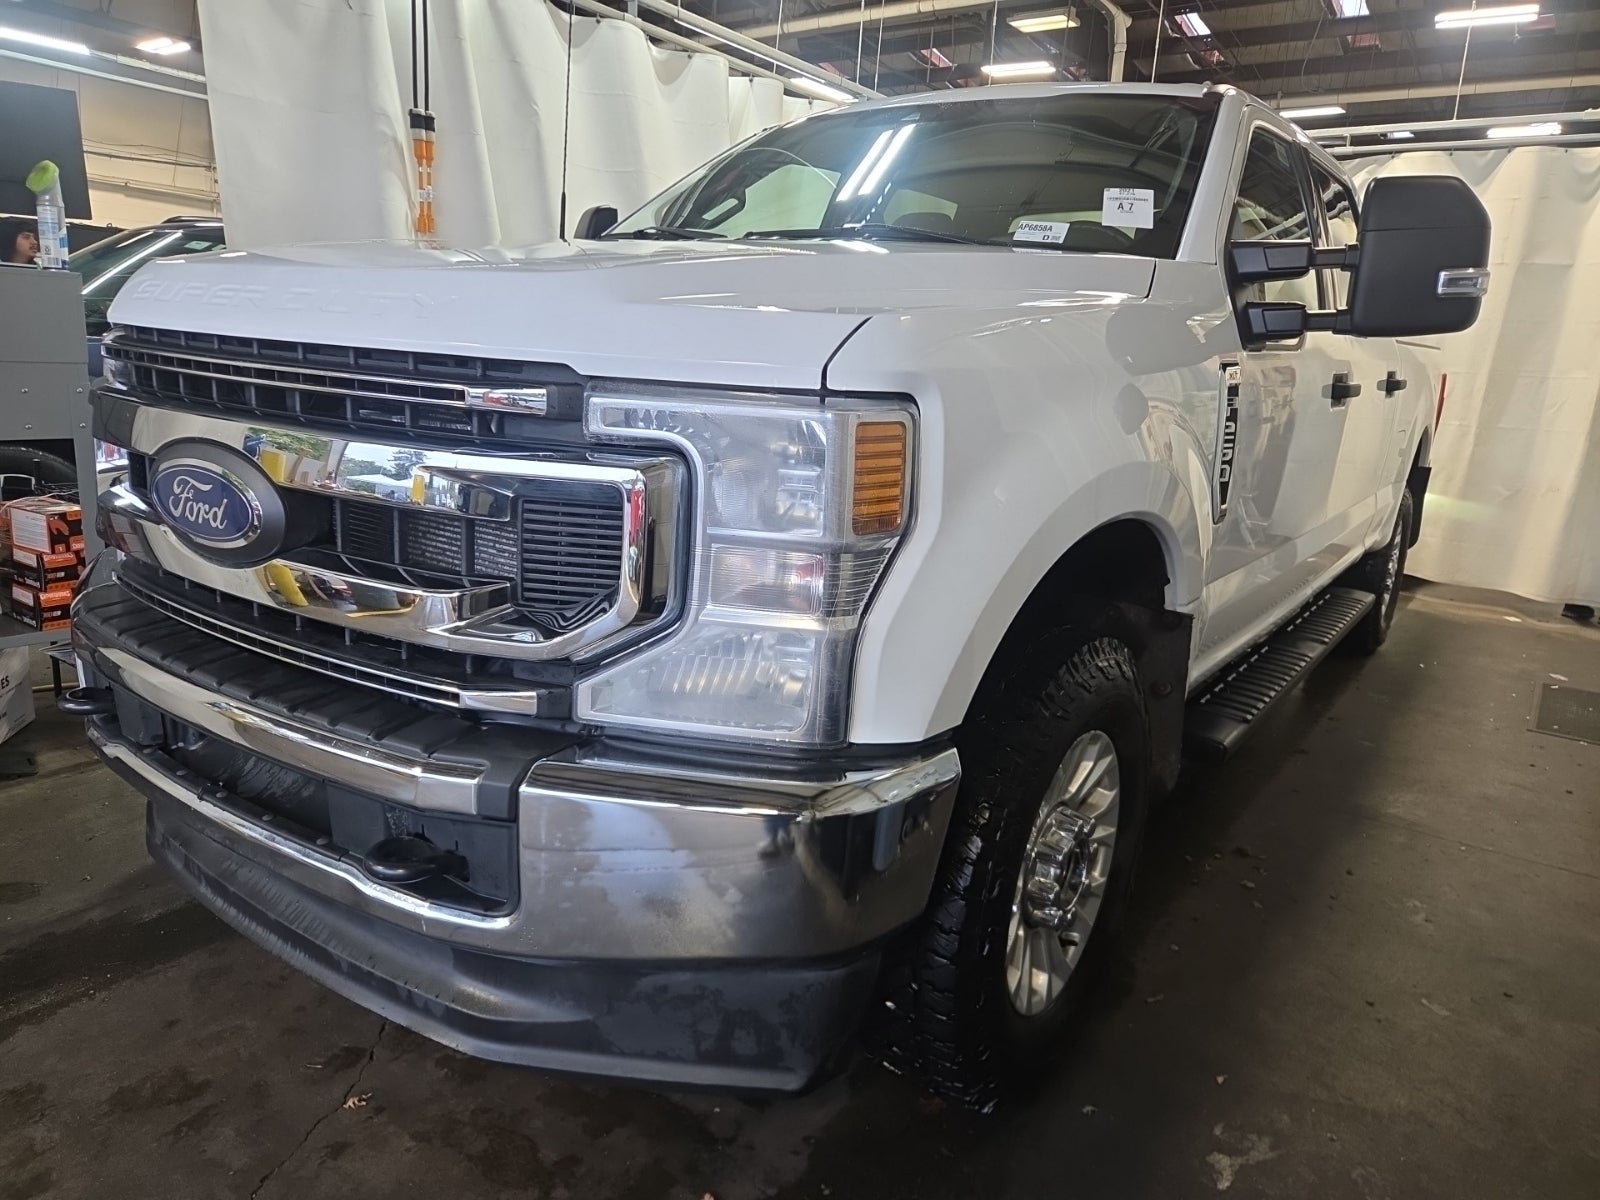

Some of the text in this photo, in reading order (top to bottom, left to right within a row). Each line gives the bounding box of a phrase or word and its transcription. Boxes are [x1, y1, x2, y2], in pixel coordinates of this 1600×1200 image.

[1117, 202, 1134, 211] A 7
[1018, 223, 1053, 232] AP6858A
[169, 475, 228, 530] Ford
